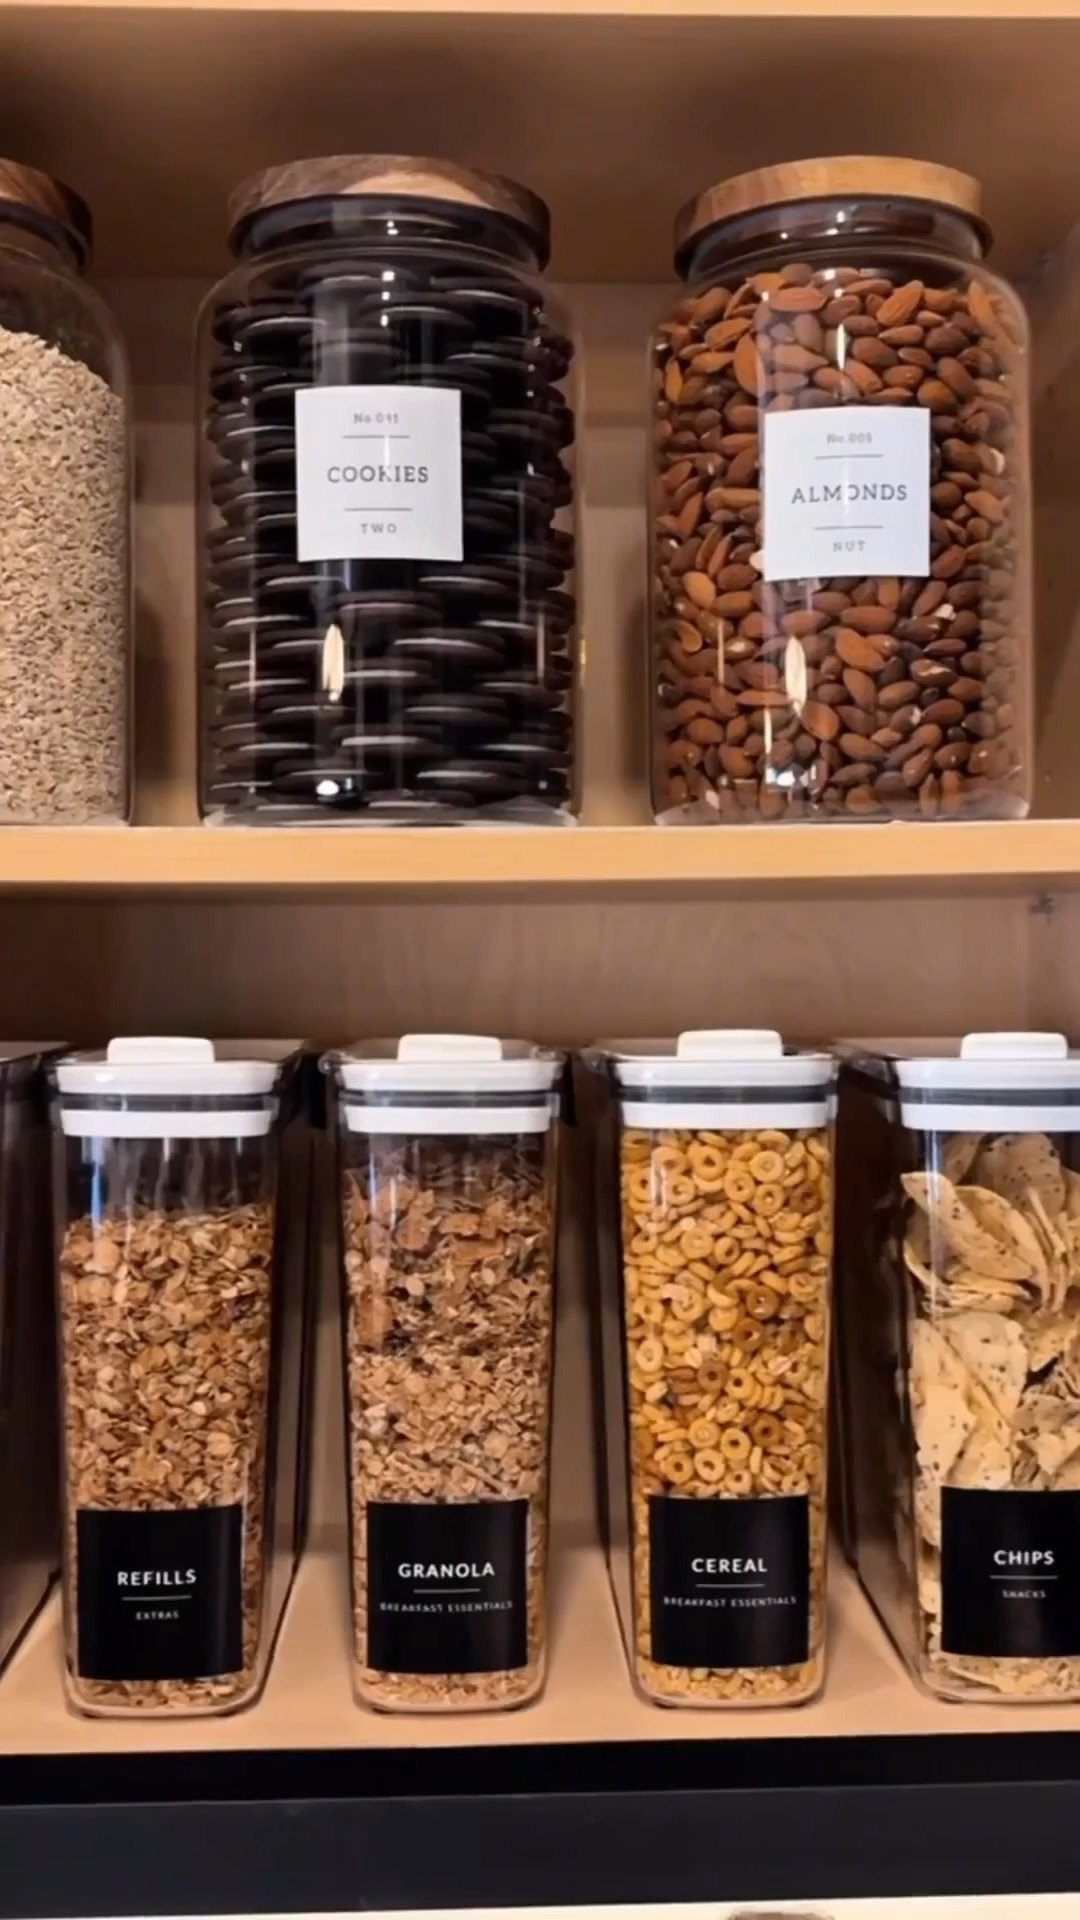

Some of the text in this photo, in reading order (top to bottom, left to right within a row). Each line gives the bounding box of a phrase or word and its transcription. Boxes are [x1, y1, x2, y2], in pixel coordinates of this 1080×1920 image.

[327, 465, 429, 483] COOKIES
[791, 484, 908, 504] ALMONDS
[360, 523, 397, 534] TWO
[832, 541, 865, 552] NUT
[993, 1549, 1054, 1565] CHIPS
[398, 1561, 495, 1578] GRANOLA
[691, 1558, 768, 1573] CEREAL
[117, 1568, 197, 1586] REFILLS
[1002, 1590, 1046, 1598] SNACKS
[380, 1601, 513, 1612] BREAKFAST ESSENTIALS
[663, 1596, 797, 1608] BREAKFAST ESSENTIALS
[136, 1610, 180, 1620] EXTRAS
